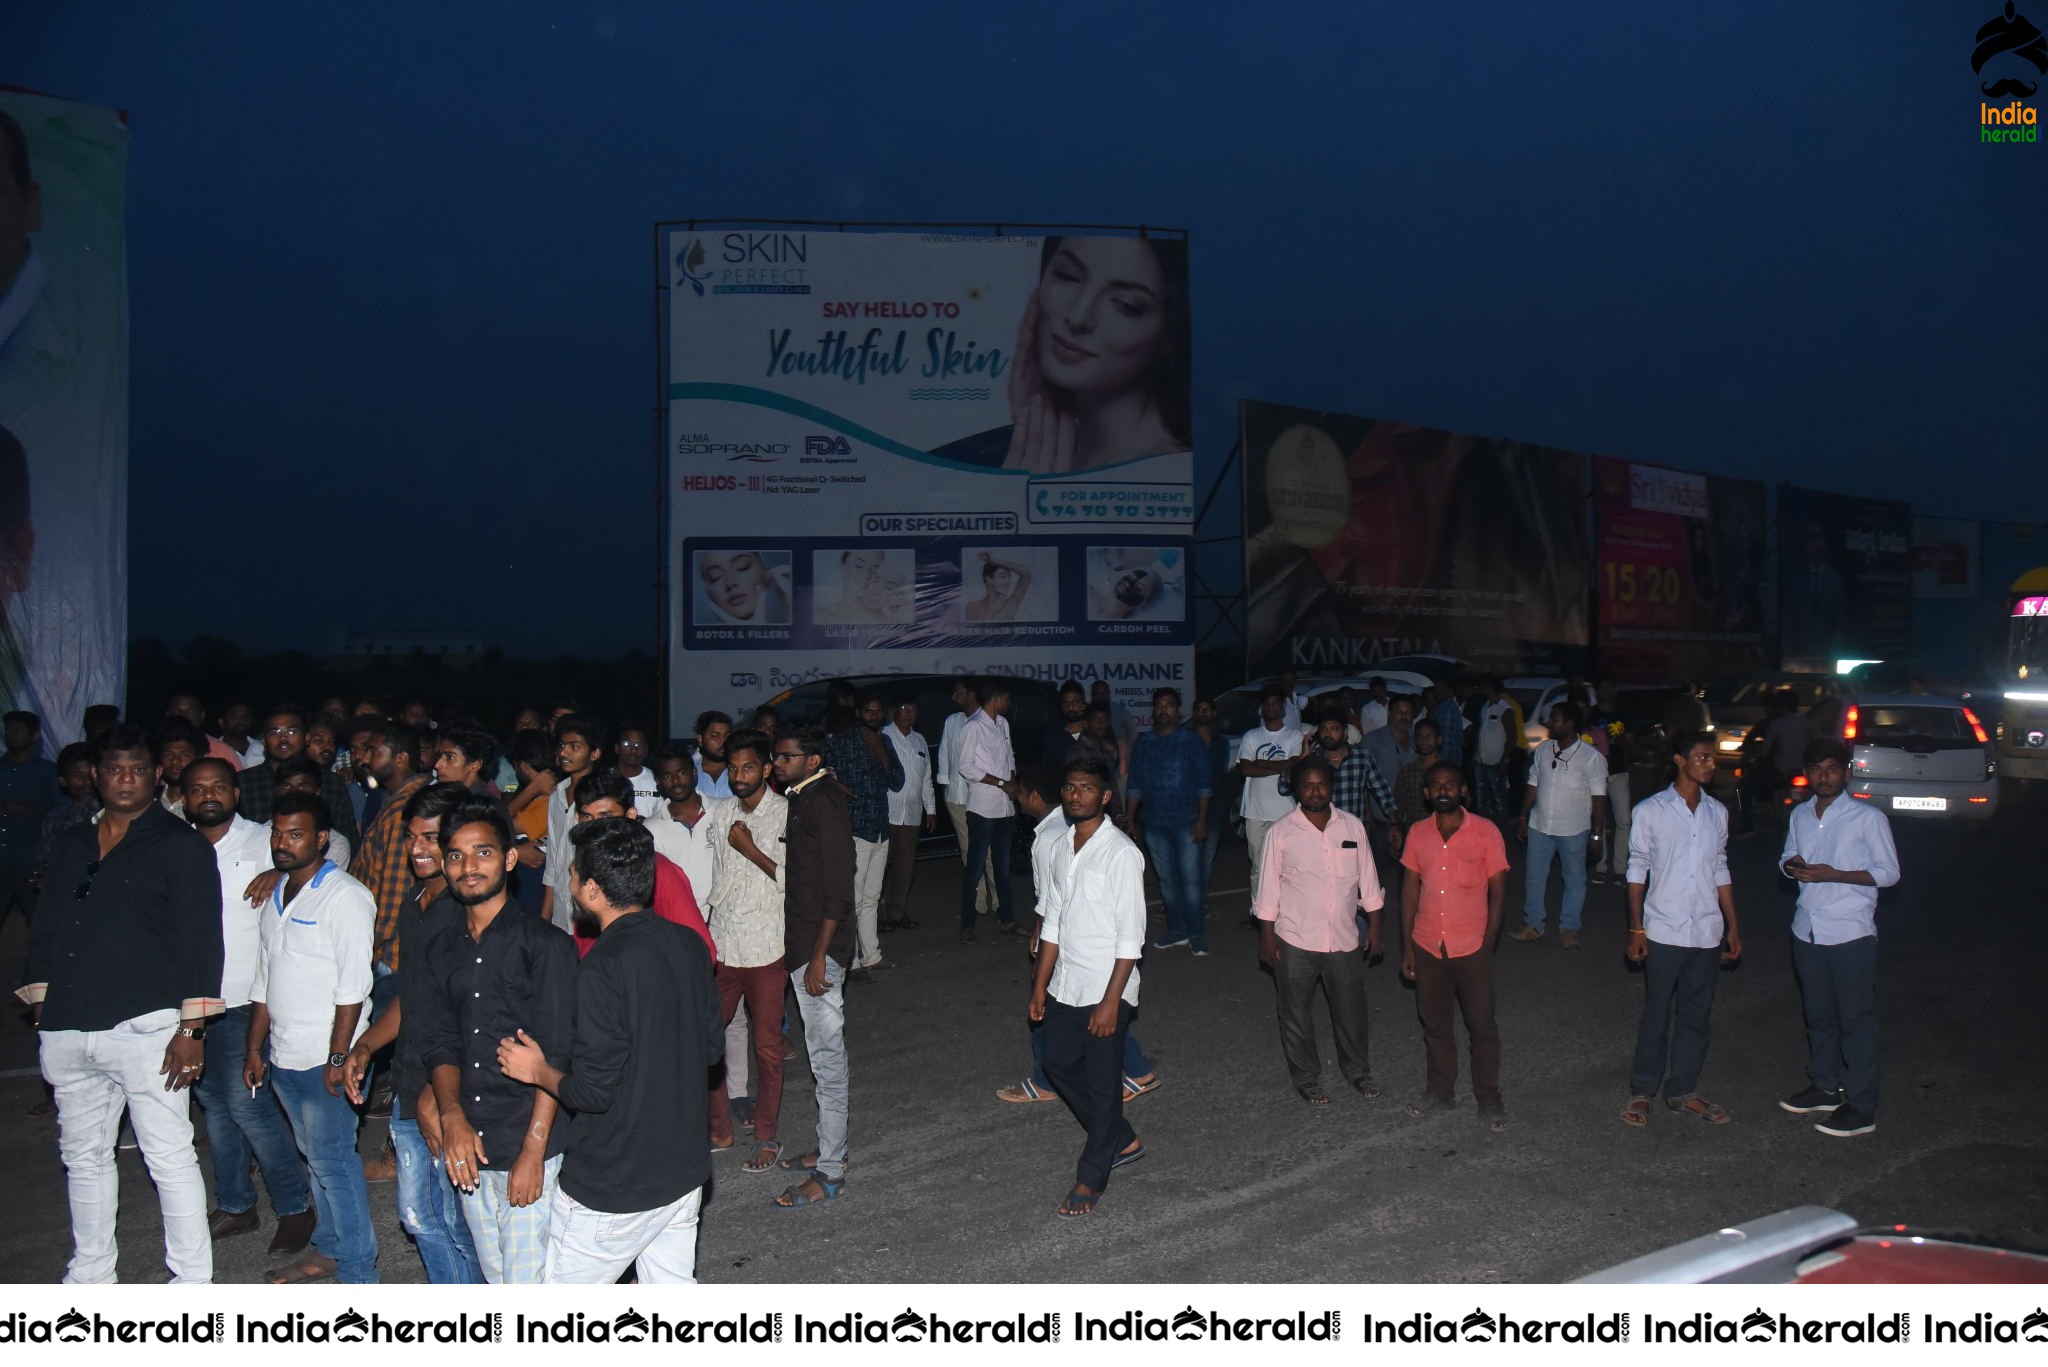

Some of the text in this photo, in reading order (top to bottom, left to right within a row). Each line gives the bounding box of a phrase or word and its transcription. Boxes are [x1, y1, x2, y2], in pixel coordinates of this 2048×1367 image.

[723, 233, 807, 263] SKIN
[723, 268, 807, 284] PERFECT
[823, 302, 960, 318] SAY HELLO TO
[766, 327, 1010, 384] Youthful Skin
[680, 434, 710, 443] ALMA
[805, 436, 852, 456] FDA
[684, 475, 736, 491] HELIOS
[779, 475, 817, 483] Fractional
[830, 475, 866, 483] Switched
[1060, 491, 1186, 502] FOR APPOINTMENT
[866, 517, 1015, 532] OUR SPECIALITIES
[1604, 562, 1681, 604] 15 20
[696, 630, 790, 640] BOTOX & FILLERS
[1014, 625, 1075, 635] REDUCTION
[1098, 624, 1171, 634] CARBON PEEL
[1103, 663, 1184, 681] MANNE
